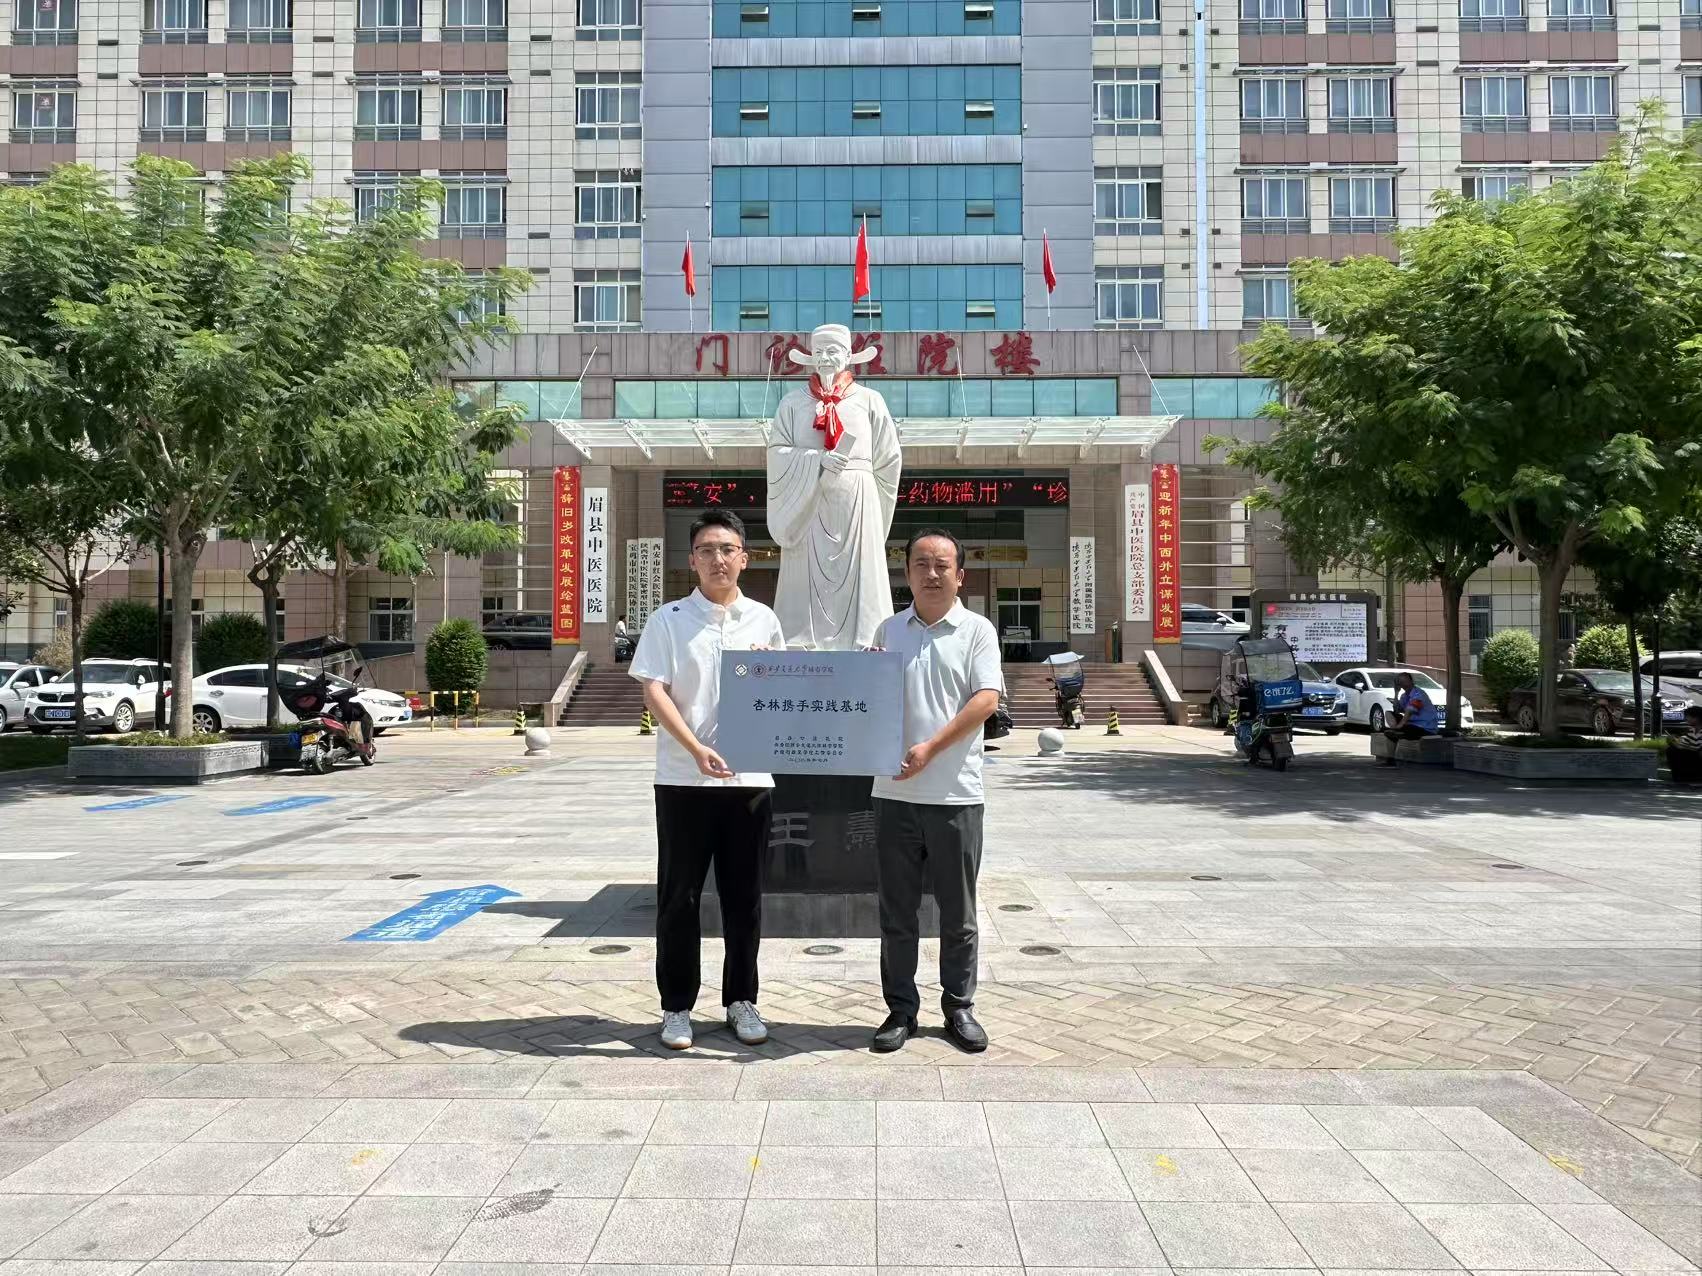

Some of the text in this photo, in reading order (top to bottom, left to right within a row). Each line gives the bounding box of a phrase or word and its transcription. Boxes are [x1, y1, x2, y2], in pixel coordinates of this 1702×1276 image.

[587, 496, 603, 613] 眉县中医医院
[753, 698, 868, 713] 杏林携手实践基地
